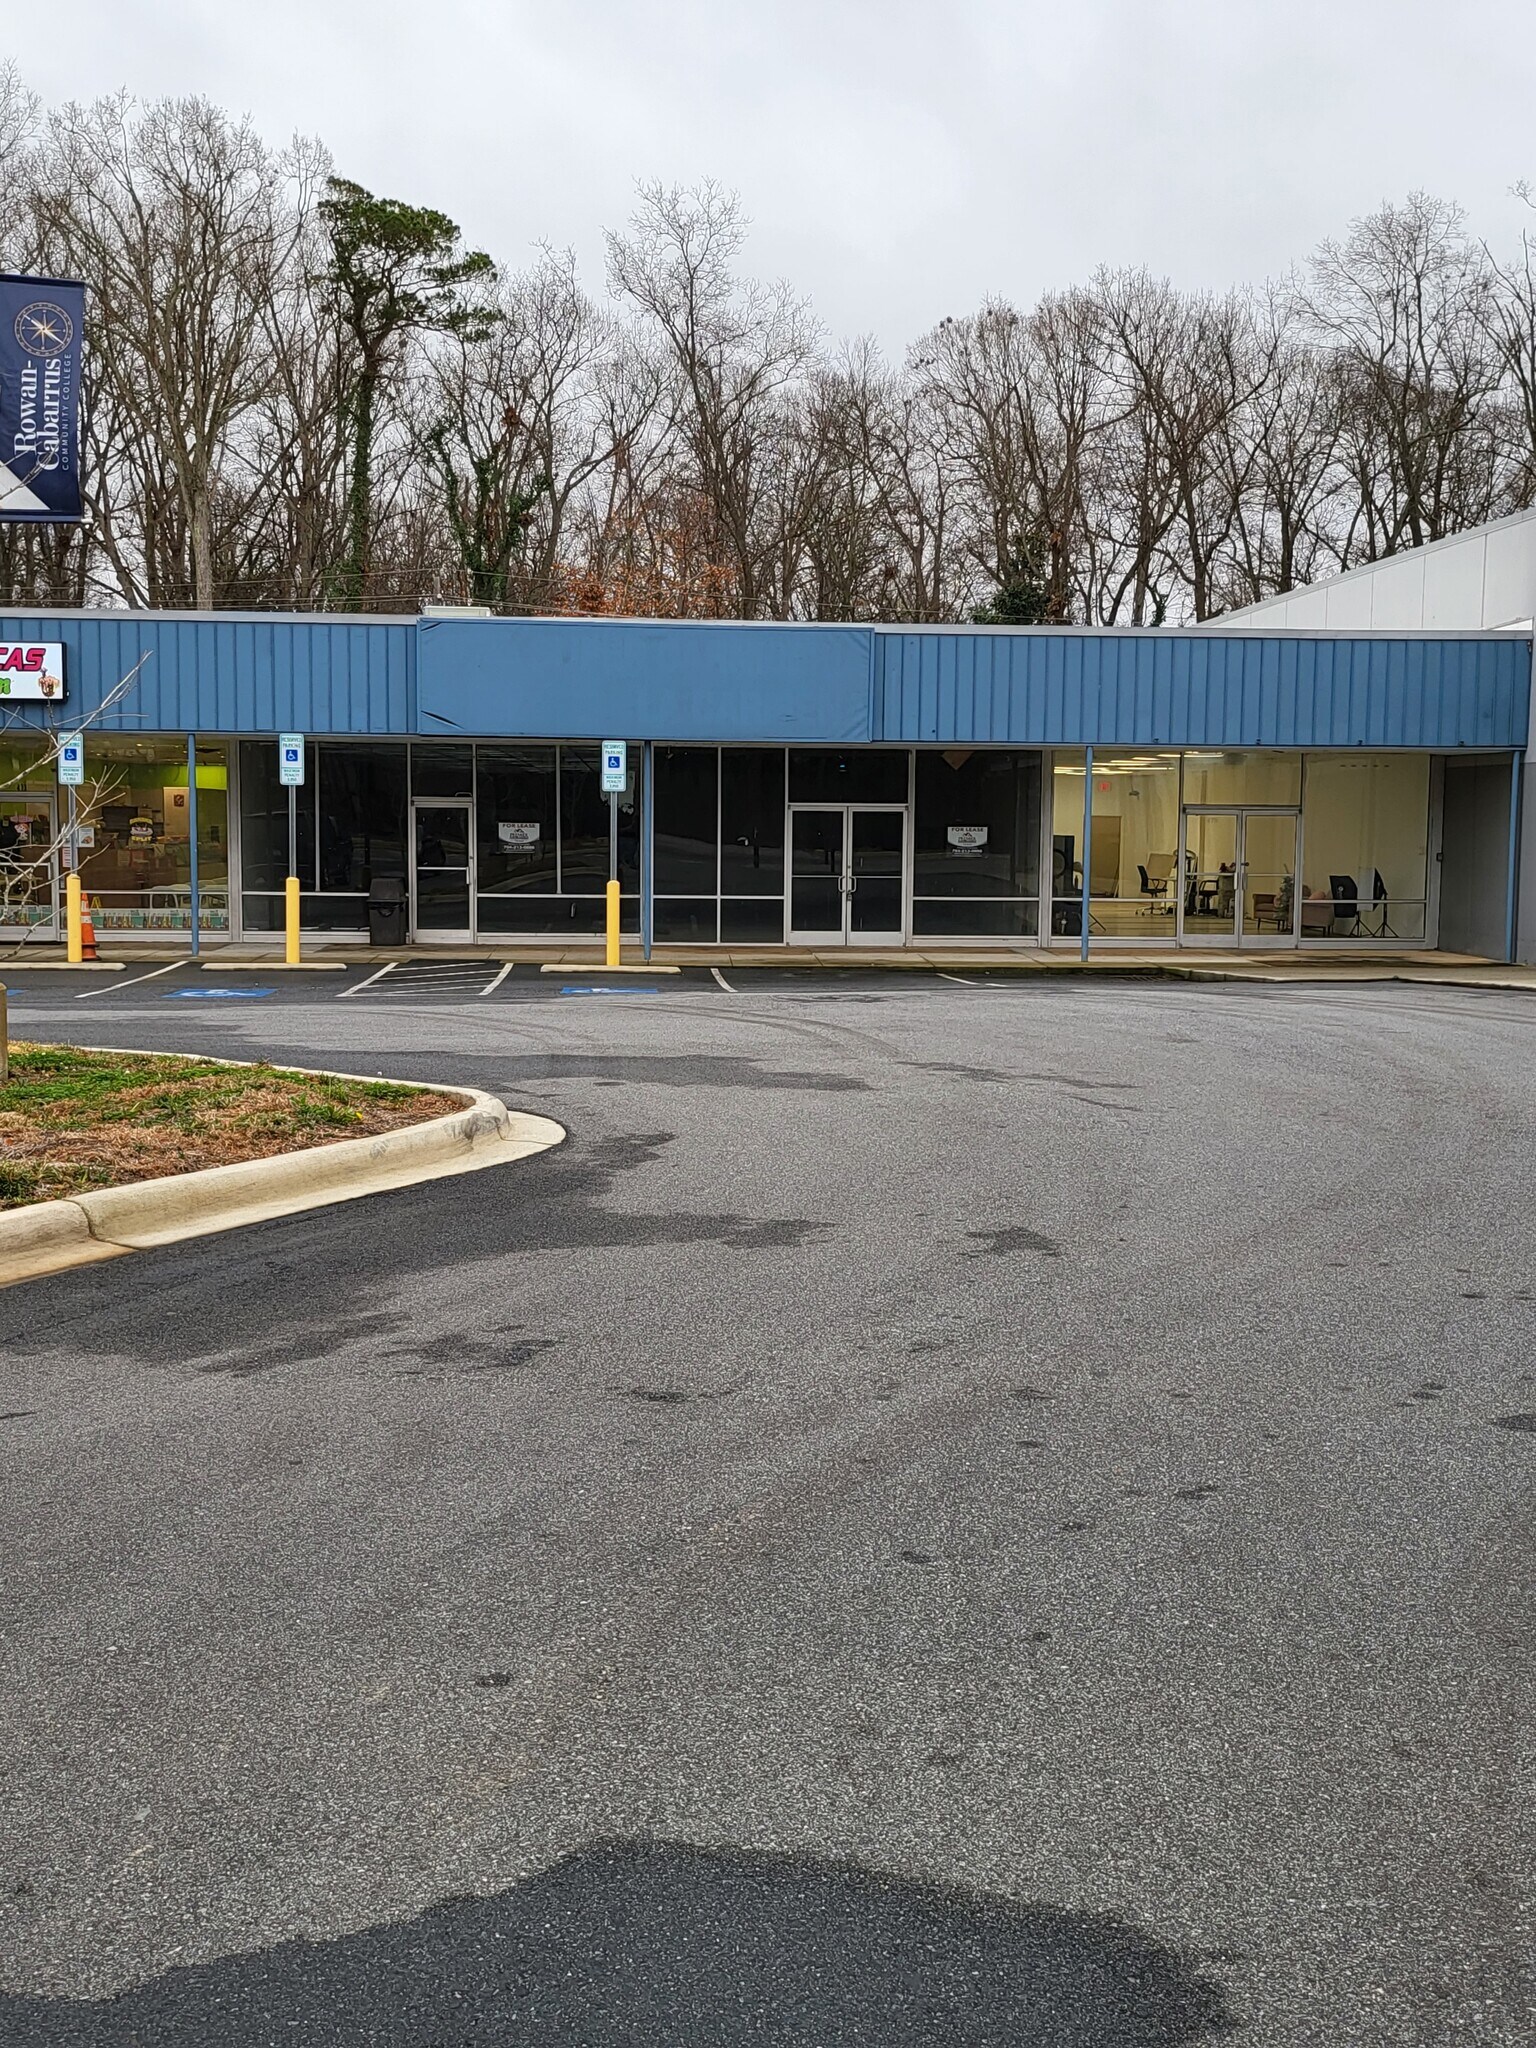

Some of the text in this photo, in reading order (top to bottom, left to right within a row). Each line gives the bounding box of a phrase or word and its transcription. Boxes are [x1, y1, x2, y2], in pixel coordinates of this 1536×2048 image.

[14, 360, 38, 455] Rowan-
[36, 357, 62, 471] Cabarrus
[62, 353, 72, 471] COMMUNITY COLLEGE
